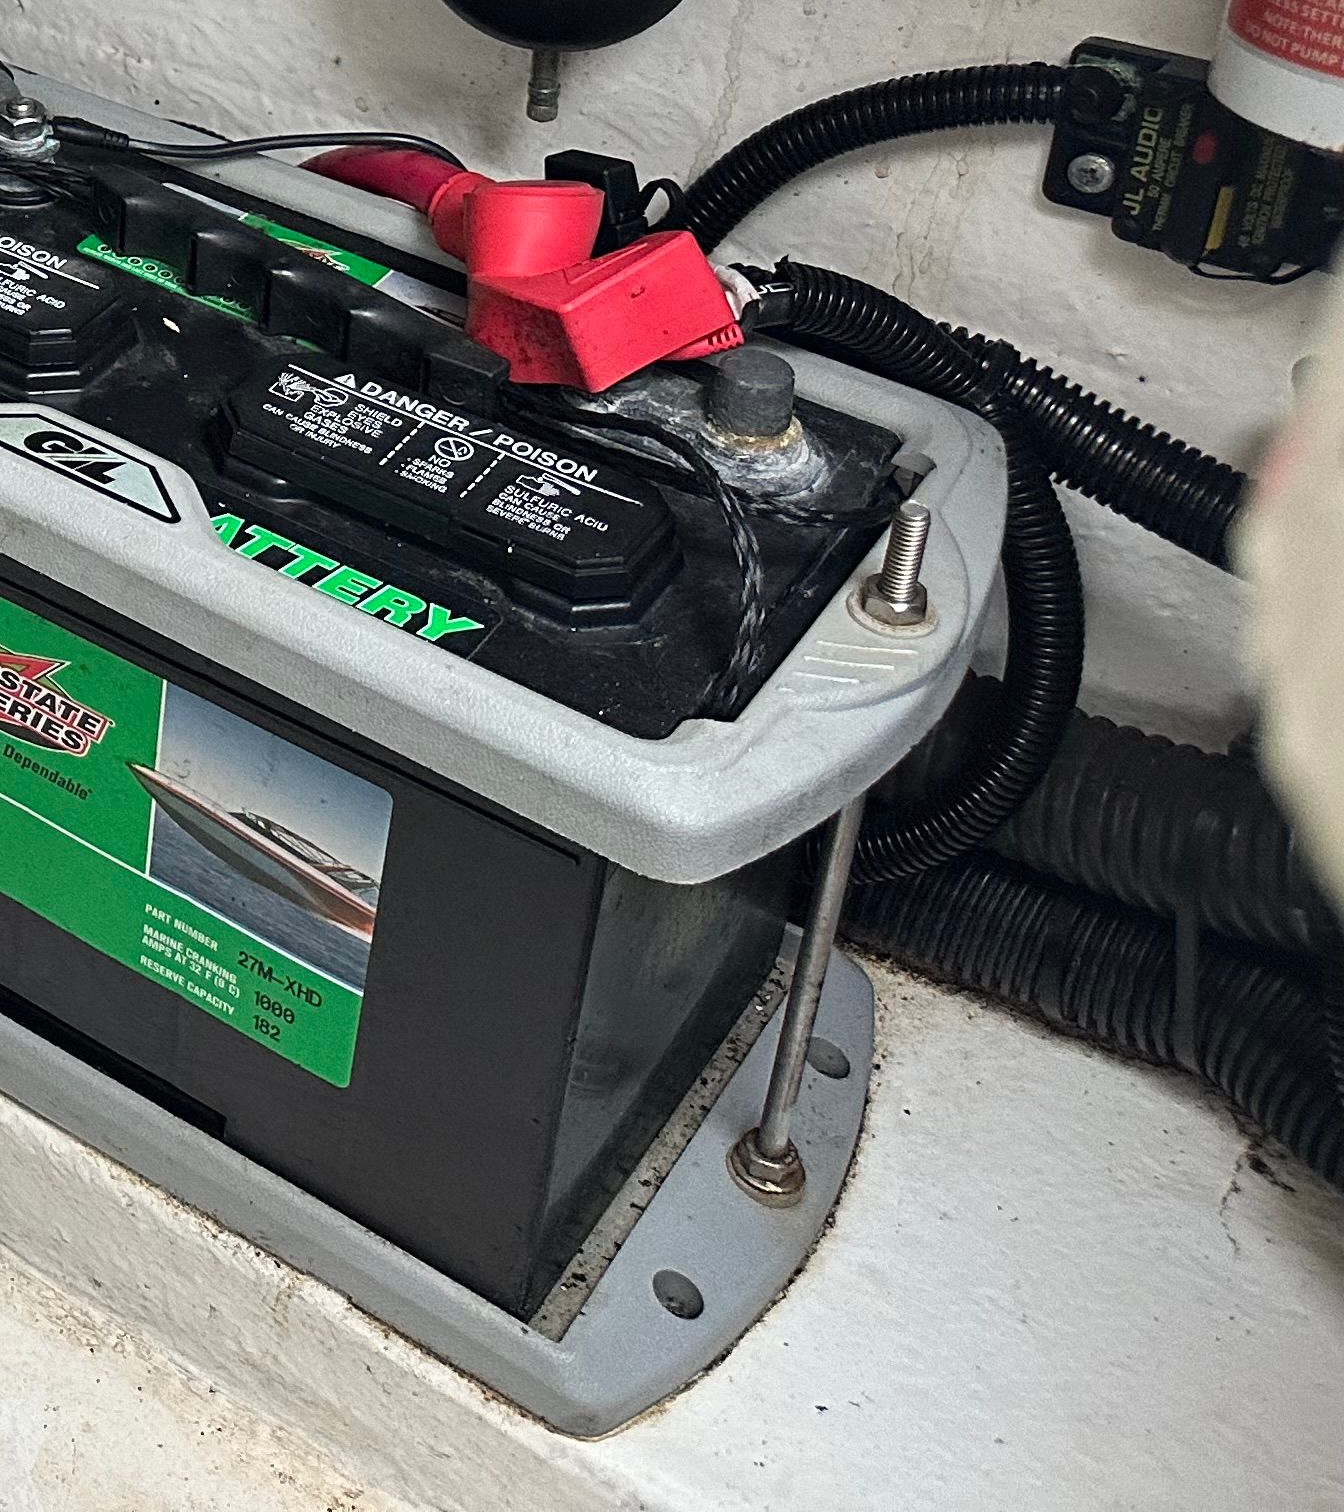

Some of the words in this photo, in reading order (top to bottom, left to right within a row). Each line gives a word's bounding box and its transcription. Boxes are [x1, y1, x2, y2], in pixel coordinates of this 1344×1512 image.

[1290, 41, 1340, 66] PUMP
[1122, 188, 1145, 216] JL
[37, 294, 66, 309] ACID
[262, 403, 283, 416] CAN
[309, 405, 384, 438] EXPLOSIVE
[347, 411, 383, 429] EYES
[354, 403, 403, 428] SHIELD
[303, 412, 347, 434] GASES
[361, 382, 470, 431] DANGER
[494, 433, 598, 483] POISON
[427, 454, 452, 469] NO
[497, 492, 521, 509] CAN
[504, 484, 573, 519] SULFURIC
[574, 513, 609, 532] ACID
[143, 924, 184, 953] MARINE
[186, 945, 237, 984] CRANKING
[145, 904, 171, 925] PART
[174, 918, 219, 951] NUMBER
[237, 951, 322, 1008] 27M-XHD
[142, 935, 172, 958] AMPS
[175, 952, 187, 966] AT
[254, 990, 295, 1025] 1000
[140, 954, 185, 987] RESERVE
[187, 981, 235, 1016] CAPACITY
[252, 1014, 281, 1042] 182
